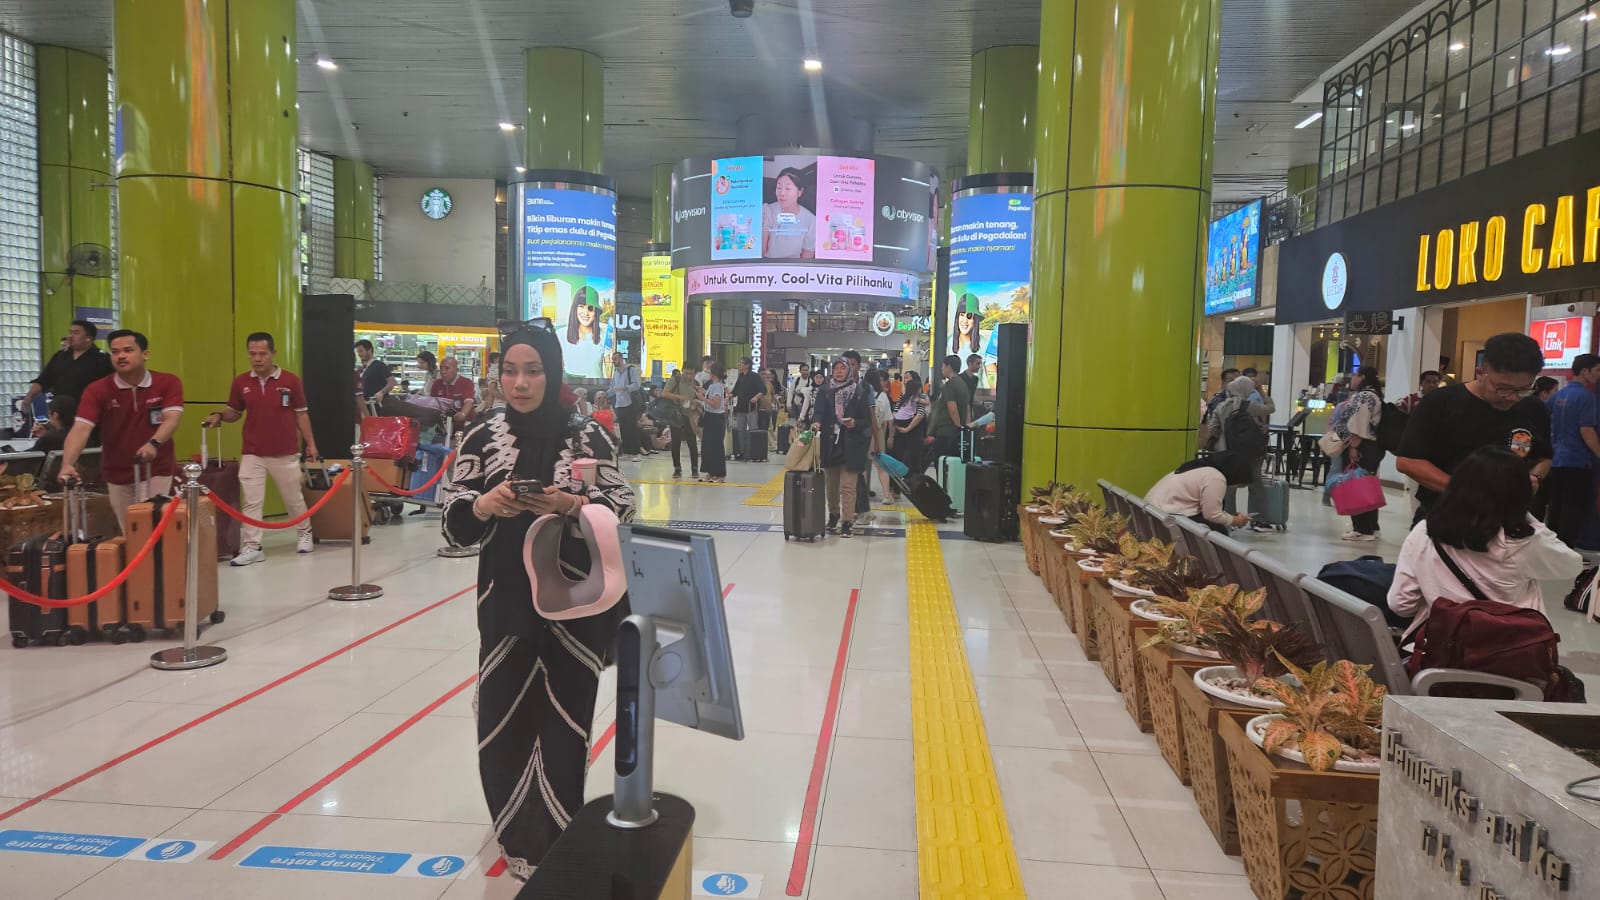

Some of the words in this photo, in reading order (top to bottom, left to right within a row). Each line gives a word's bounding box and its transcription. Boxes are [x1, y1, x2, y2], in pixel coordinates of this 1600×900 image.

[546, 214, 577, 224] liburan
[569, 227, 587, 236] dulu
[978, 231, 1027, 242] Pegadaian!
[1416, 215, 1506, 291] LOKO
[703, 273, 727, 285] Untuk
[781, 272, 842, 286] Cool-Vita
[846, 274, 893, 289] Pilihanku
[1545, 339, 1563, 351] Link
[5, 840, 52, 849] antre
[53, 843, 107, 855] Harap
[320, 859, 375, 871] Harap
